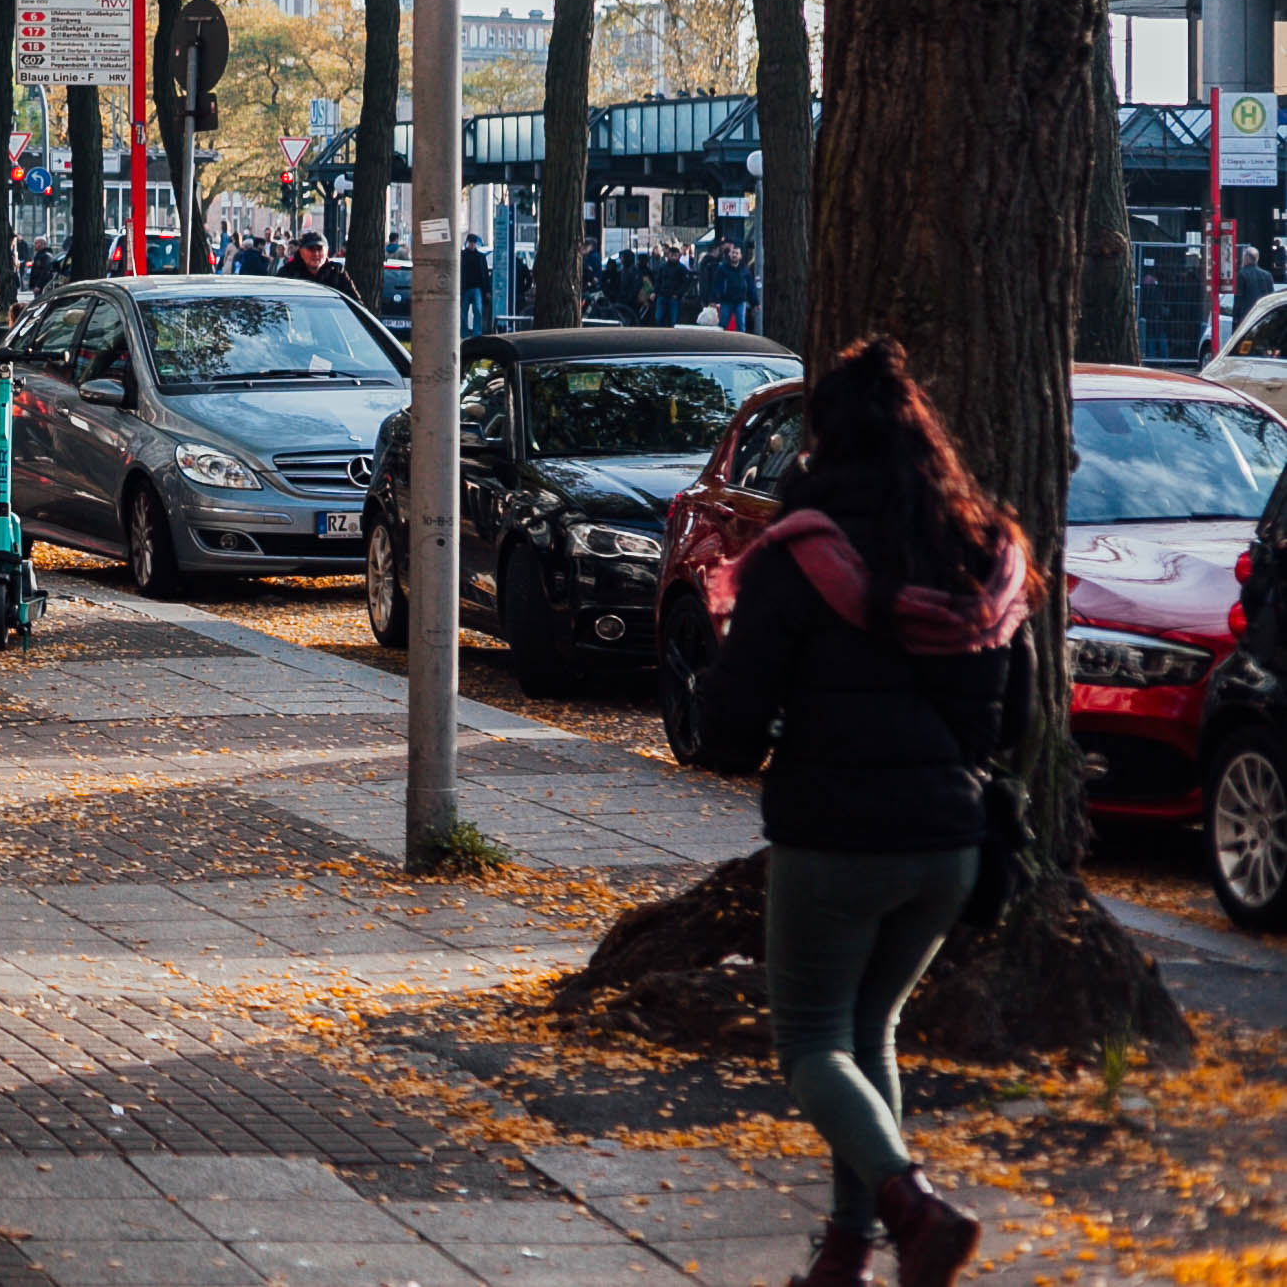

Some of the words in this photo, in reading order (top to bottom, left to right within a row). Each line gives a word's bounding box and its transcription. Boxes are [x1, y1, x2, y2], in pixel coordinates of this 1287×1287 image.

[30, 13, 37, 21] 6
[28, 28, 40, 36] 17
[28, 43, 40, 51] 18
[24, 56, 42, 64] 607
[20, 73, 50, 82] Blaue
[53, 73, 79, 82] Linie
[88, 73, 95, 82] F
[328, 515, 347, 532] RZ
